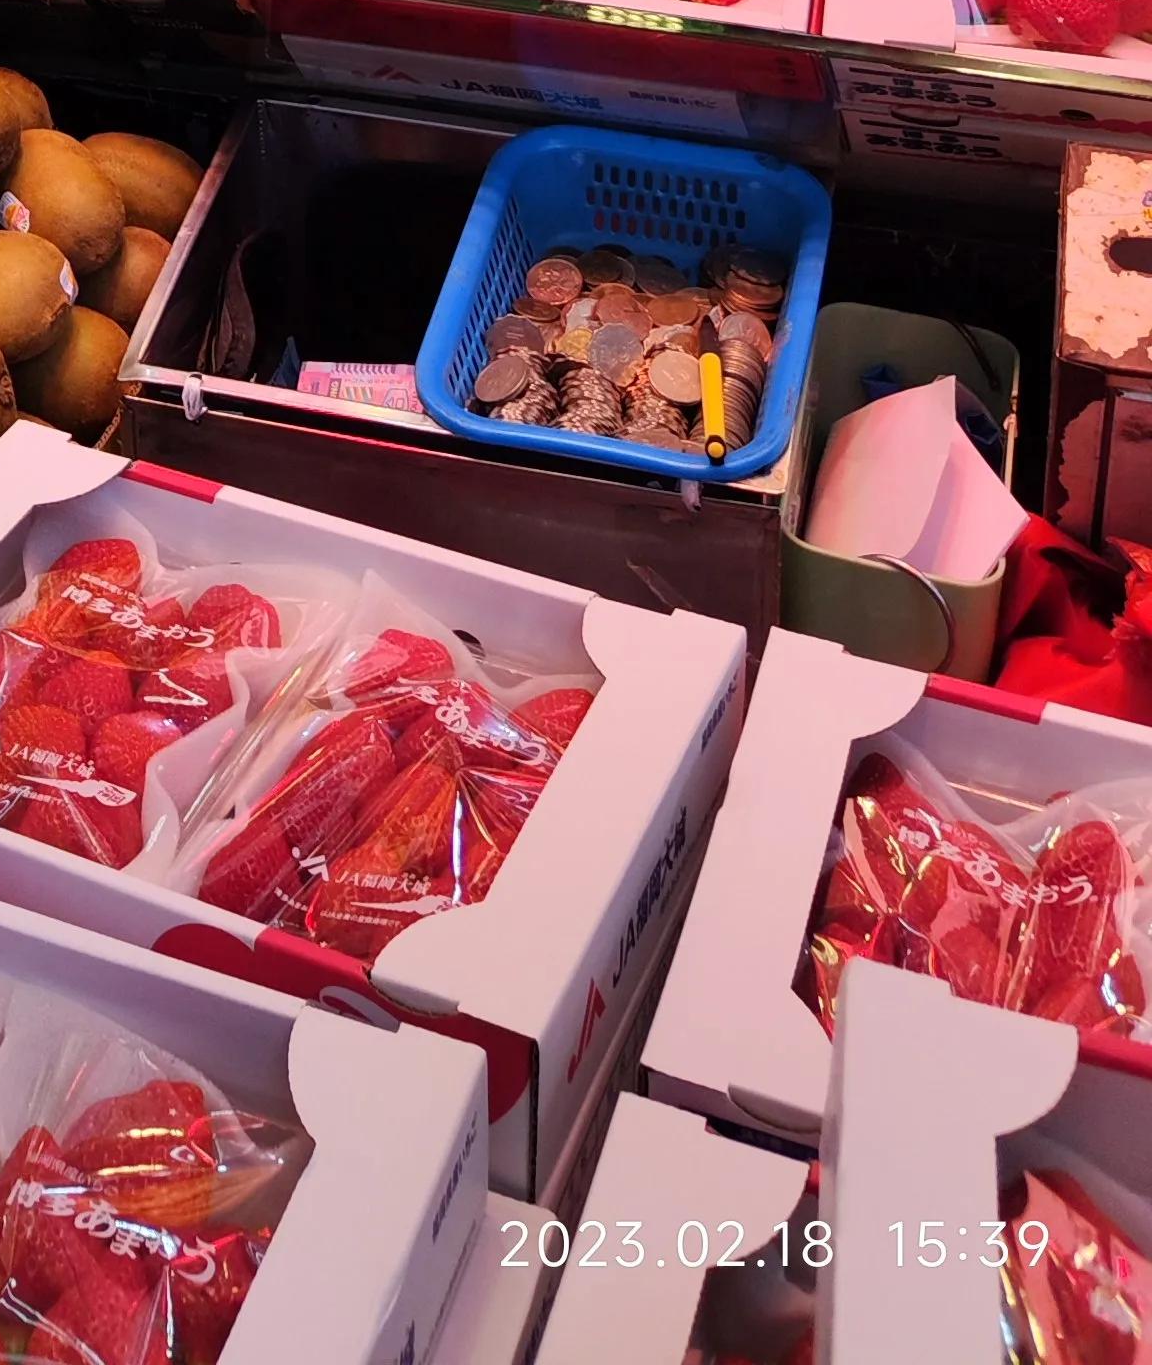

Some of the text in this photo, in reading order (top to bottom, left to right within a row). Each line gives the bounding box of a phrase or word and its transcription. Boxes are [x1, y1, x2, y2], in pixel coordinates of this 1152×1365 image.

[440, 79, 603, 110] JA福岡大城
[61, 584, 216, 649] 博多あまおう
